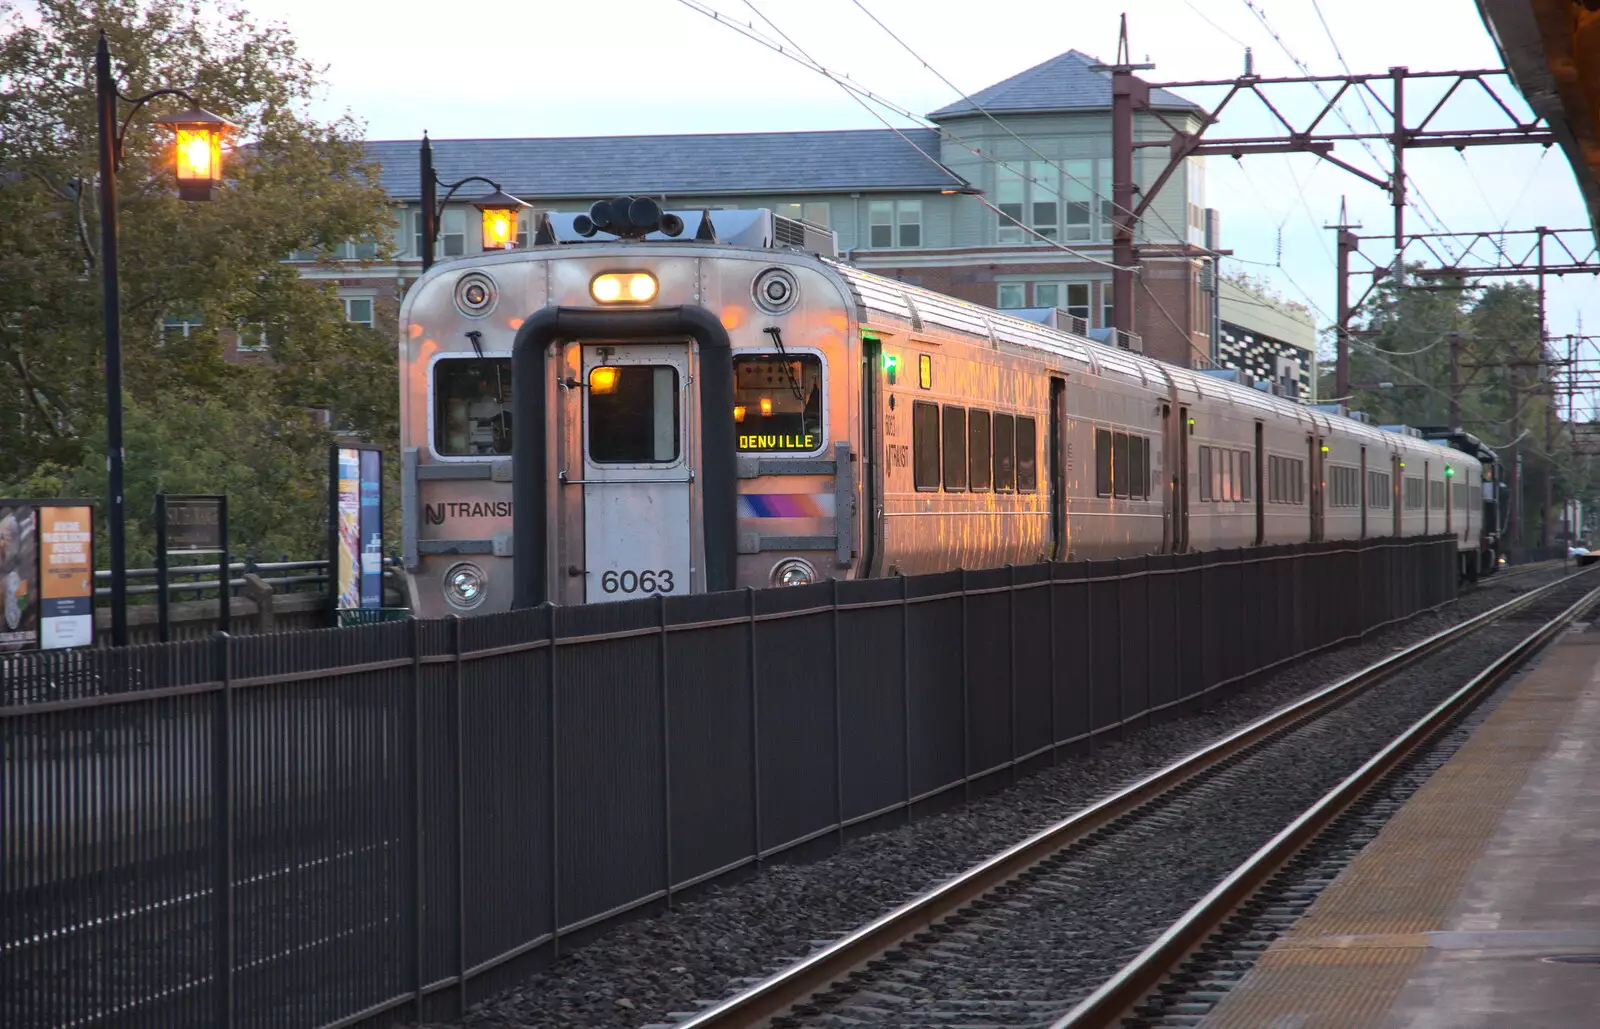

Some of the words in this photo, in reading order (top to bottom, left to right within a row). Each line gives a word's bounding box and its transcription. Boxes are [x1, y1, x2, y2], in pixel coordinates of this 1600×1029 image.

[739, 435, 814, 449] DENVILLE
[425, 502, 445, 525] NJ
[446, 502, 513, 517] TRANSI
[601, 569, 675, 594] 6063
